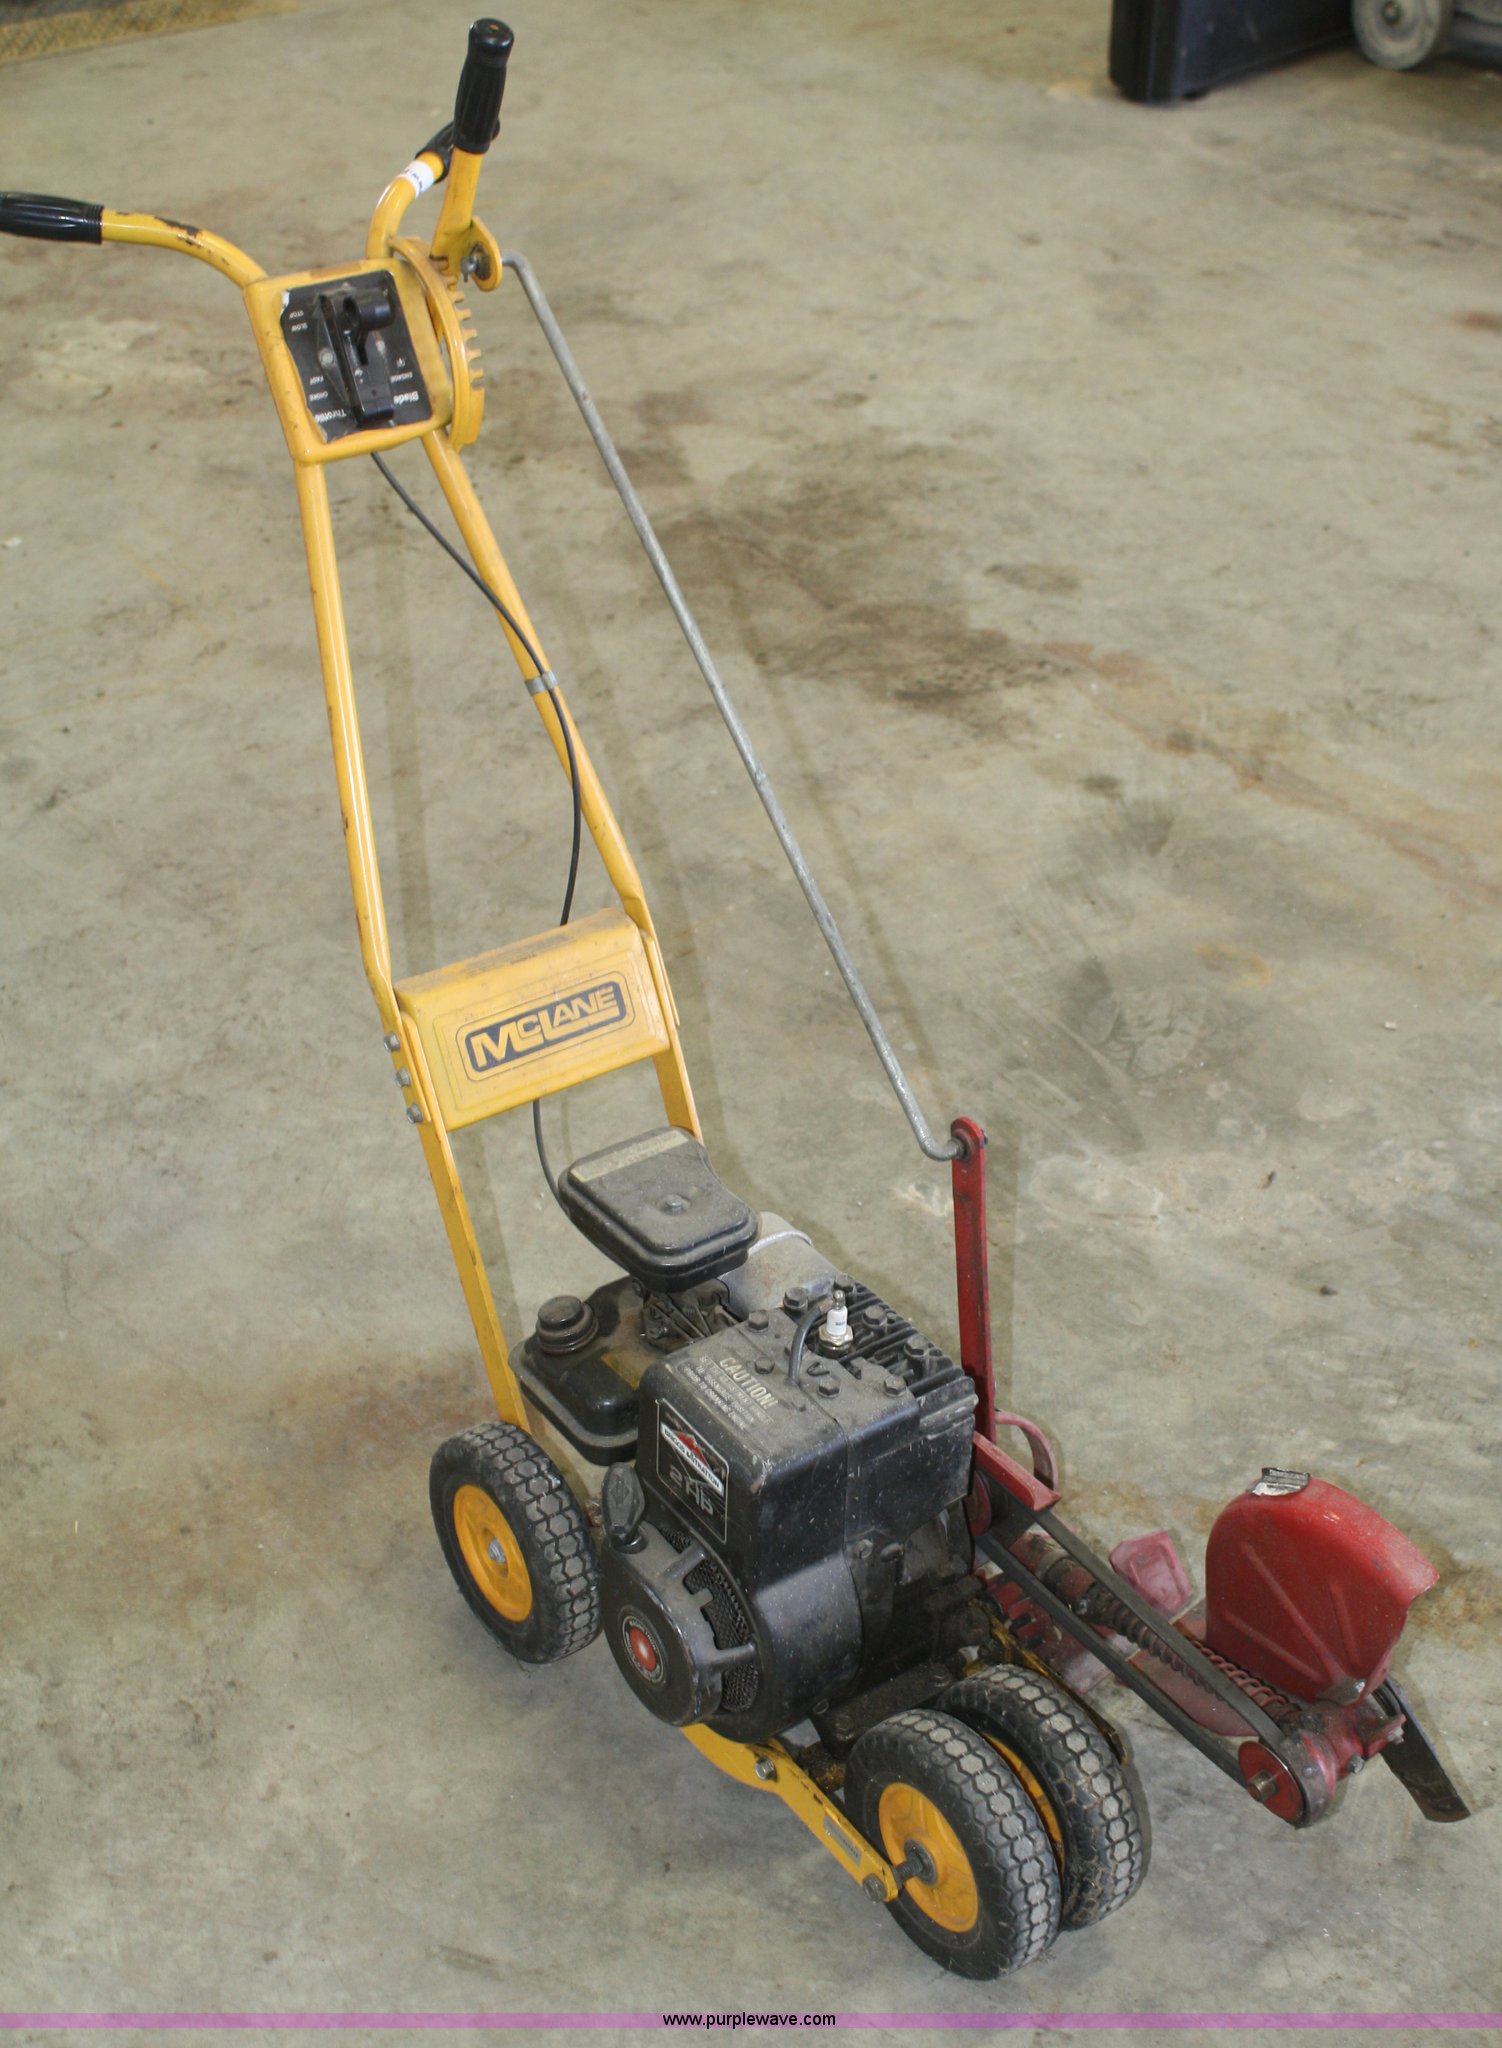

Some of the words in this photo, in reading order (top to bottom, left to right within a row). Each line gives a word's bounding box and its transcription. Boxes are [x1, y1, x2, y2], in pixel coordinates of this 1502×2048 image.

[393, 390, 419, 405] Blade
[719, 1357, 779, 1409] CAUTION!
[664, 1428, 686, 1453] BRIGGS
[690, 1455, 720, 1488] STRATTON
[669, 1464, 682, 1488] 2
